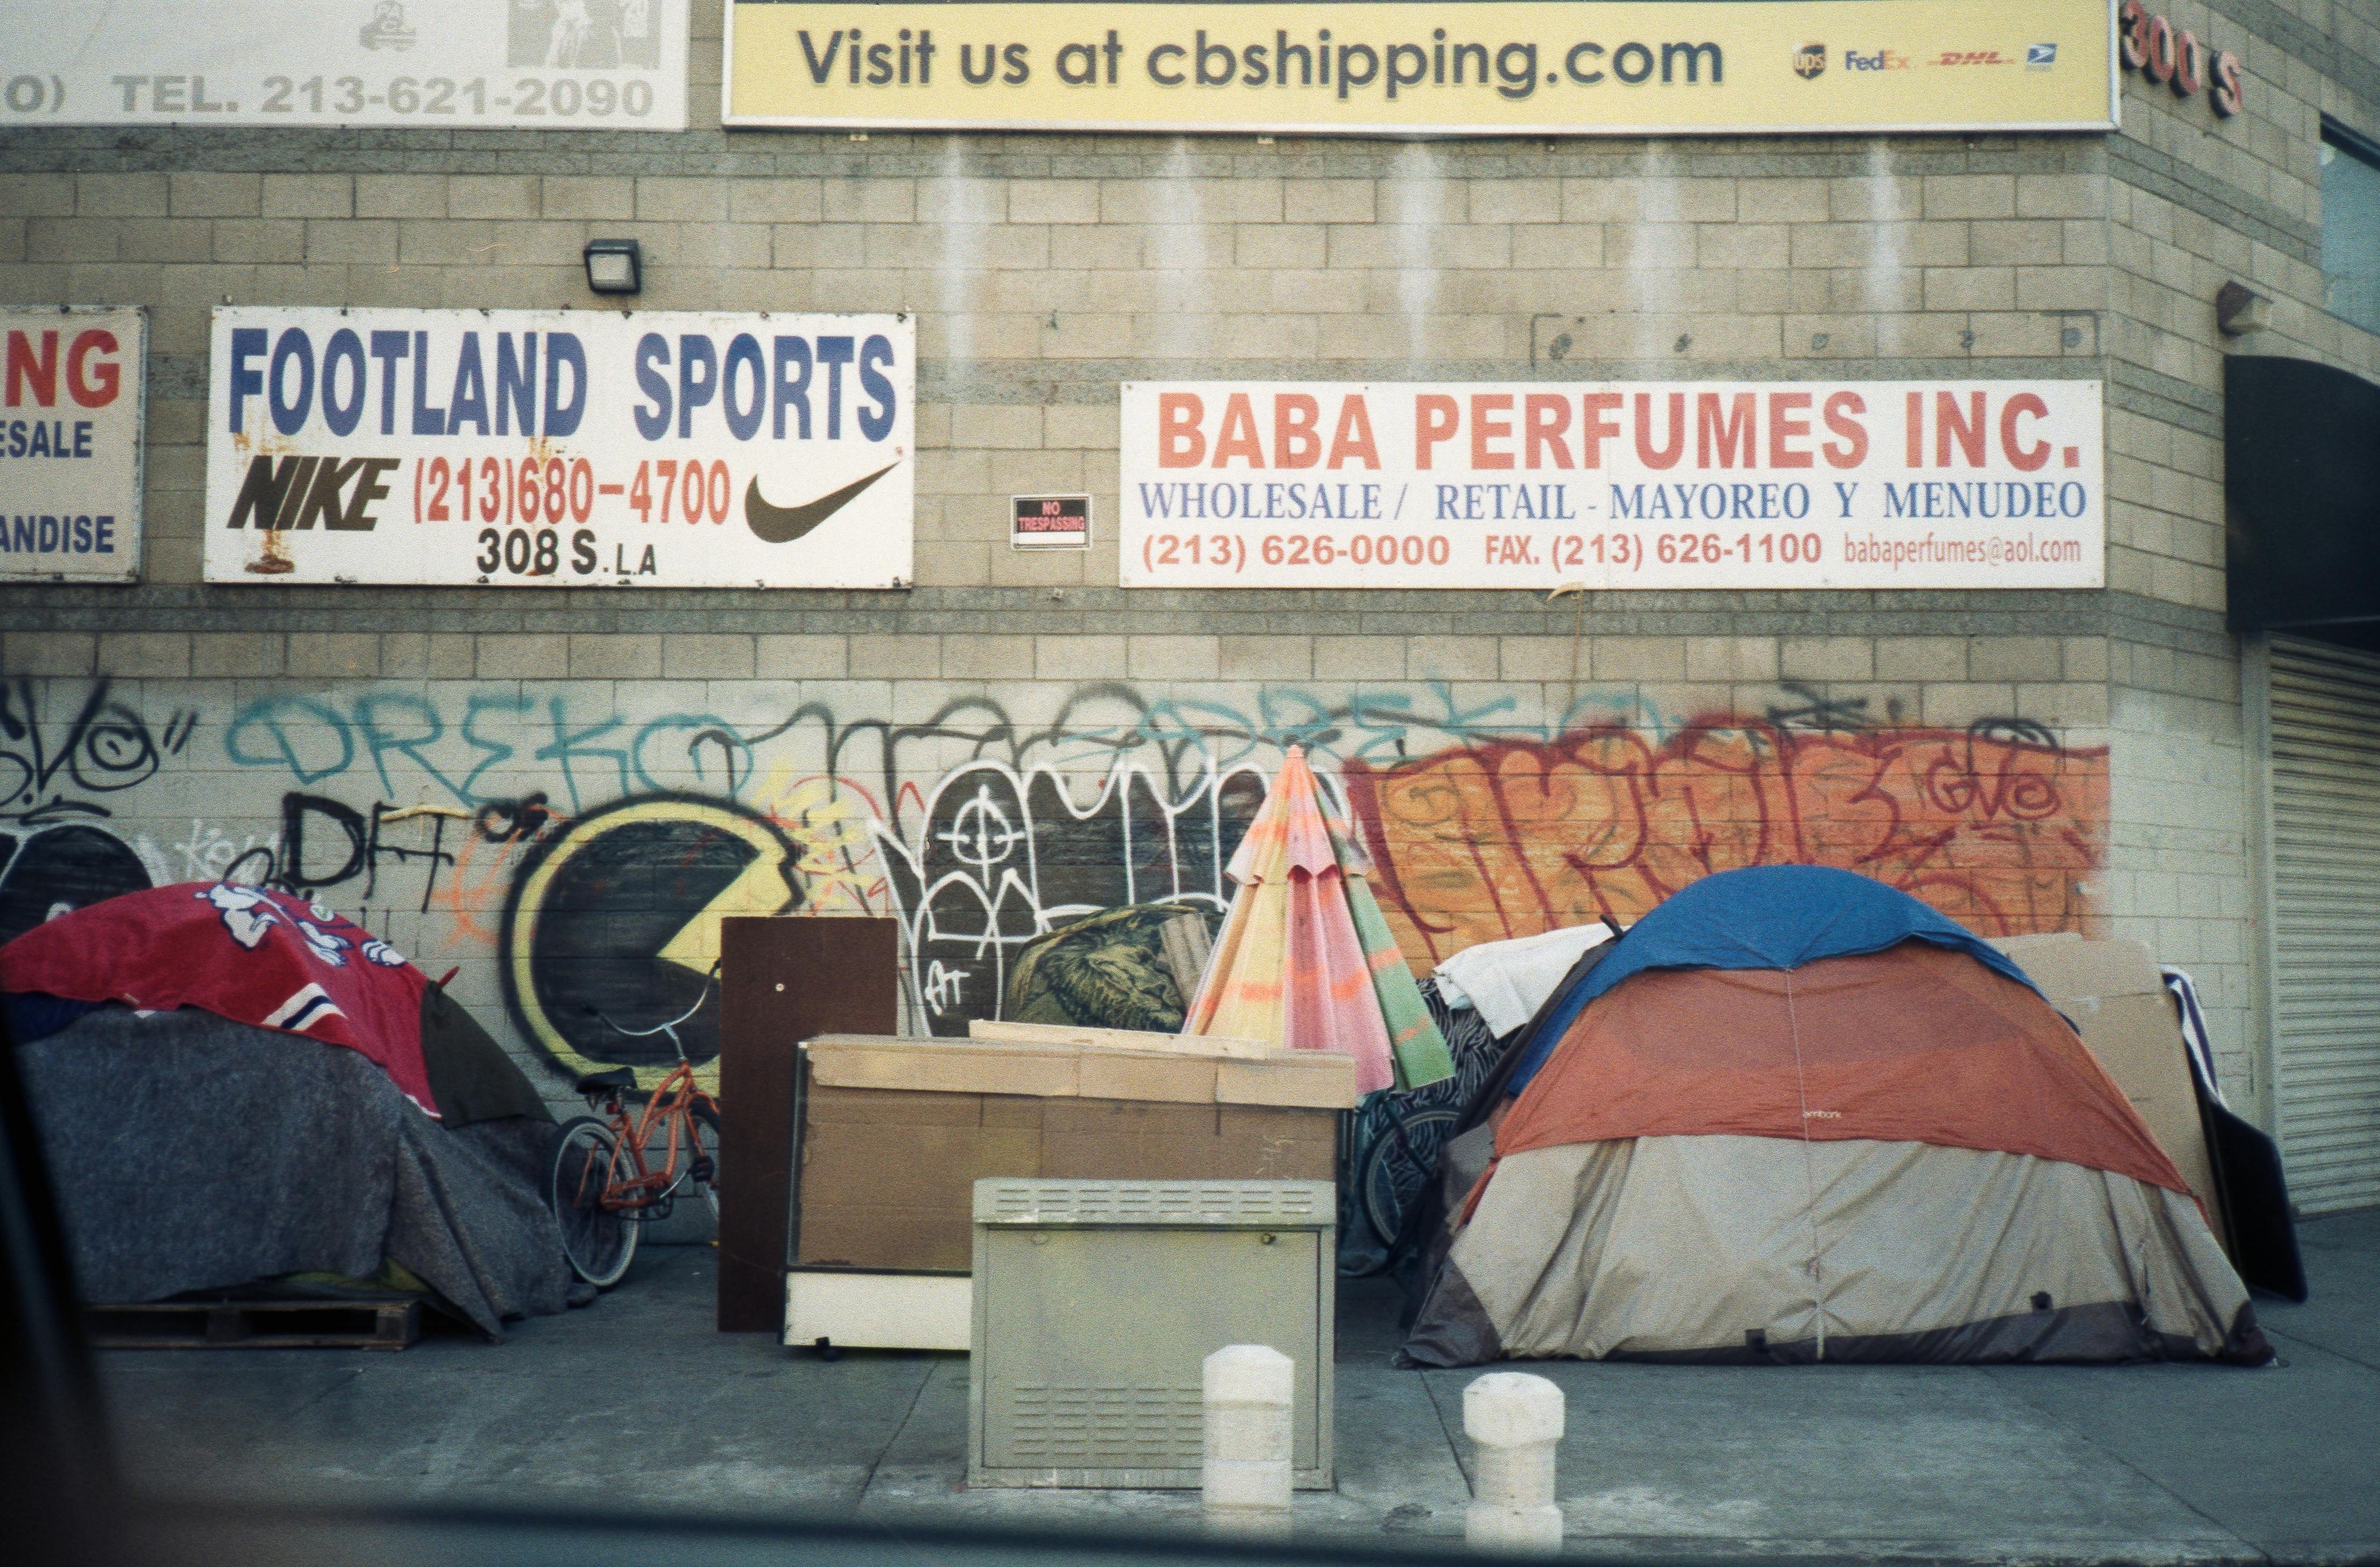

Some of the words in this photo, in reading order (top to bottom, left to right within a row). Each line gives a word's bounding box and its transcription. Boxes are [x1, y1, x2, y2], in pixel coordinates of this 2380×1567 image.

[797, 29, 935, 85] Visit
[960, 43, 1031, 85] us
[1055, 30, 1123, 85] at
[1146, 28, 1722, 99] cbshipping.com
[1845, 49, 1911, 71] FedEx
[1938, 51, 2003, 66] DHL
[111, 75, 239, 113] TEL.
[262, 75, 655, 117] 213-621-2090
[228, 327, 588, 438] FOOTLAND
[633, 332, 898, 442] SPORTS
[0, 420, 93, 458] SALE
[1158, 392, 1382, 470] BABA
[1415, 390, 1870, 471] PERFUMES
[1905, 390, 2081, 472] INC.
[226, 455, 401, 532] NIKE
[413, 456, 732, 526] (213)680-4700
[1042, 500, 1061, 516] NO
[1435, 483, 1576, 520] RETAIL
[1609, 483, 1811, 520] MAYOREO
[1833, 481, 1860, 518] Y
[1883, 481, 2087, 519] MENUDEO
[476, 527, 560, 575] 308
[1142, 533, 1247, 574] (213)
[1261, 533, 1451, 565] 626-0000
[1485, 534, 1540, 565] FAX.
[1552, 533, 1644, 572] (213)
[1656, 532, 1823, 564] 626-1100
[1844, 531, 2081, 571] babaperfumes@aol.com
